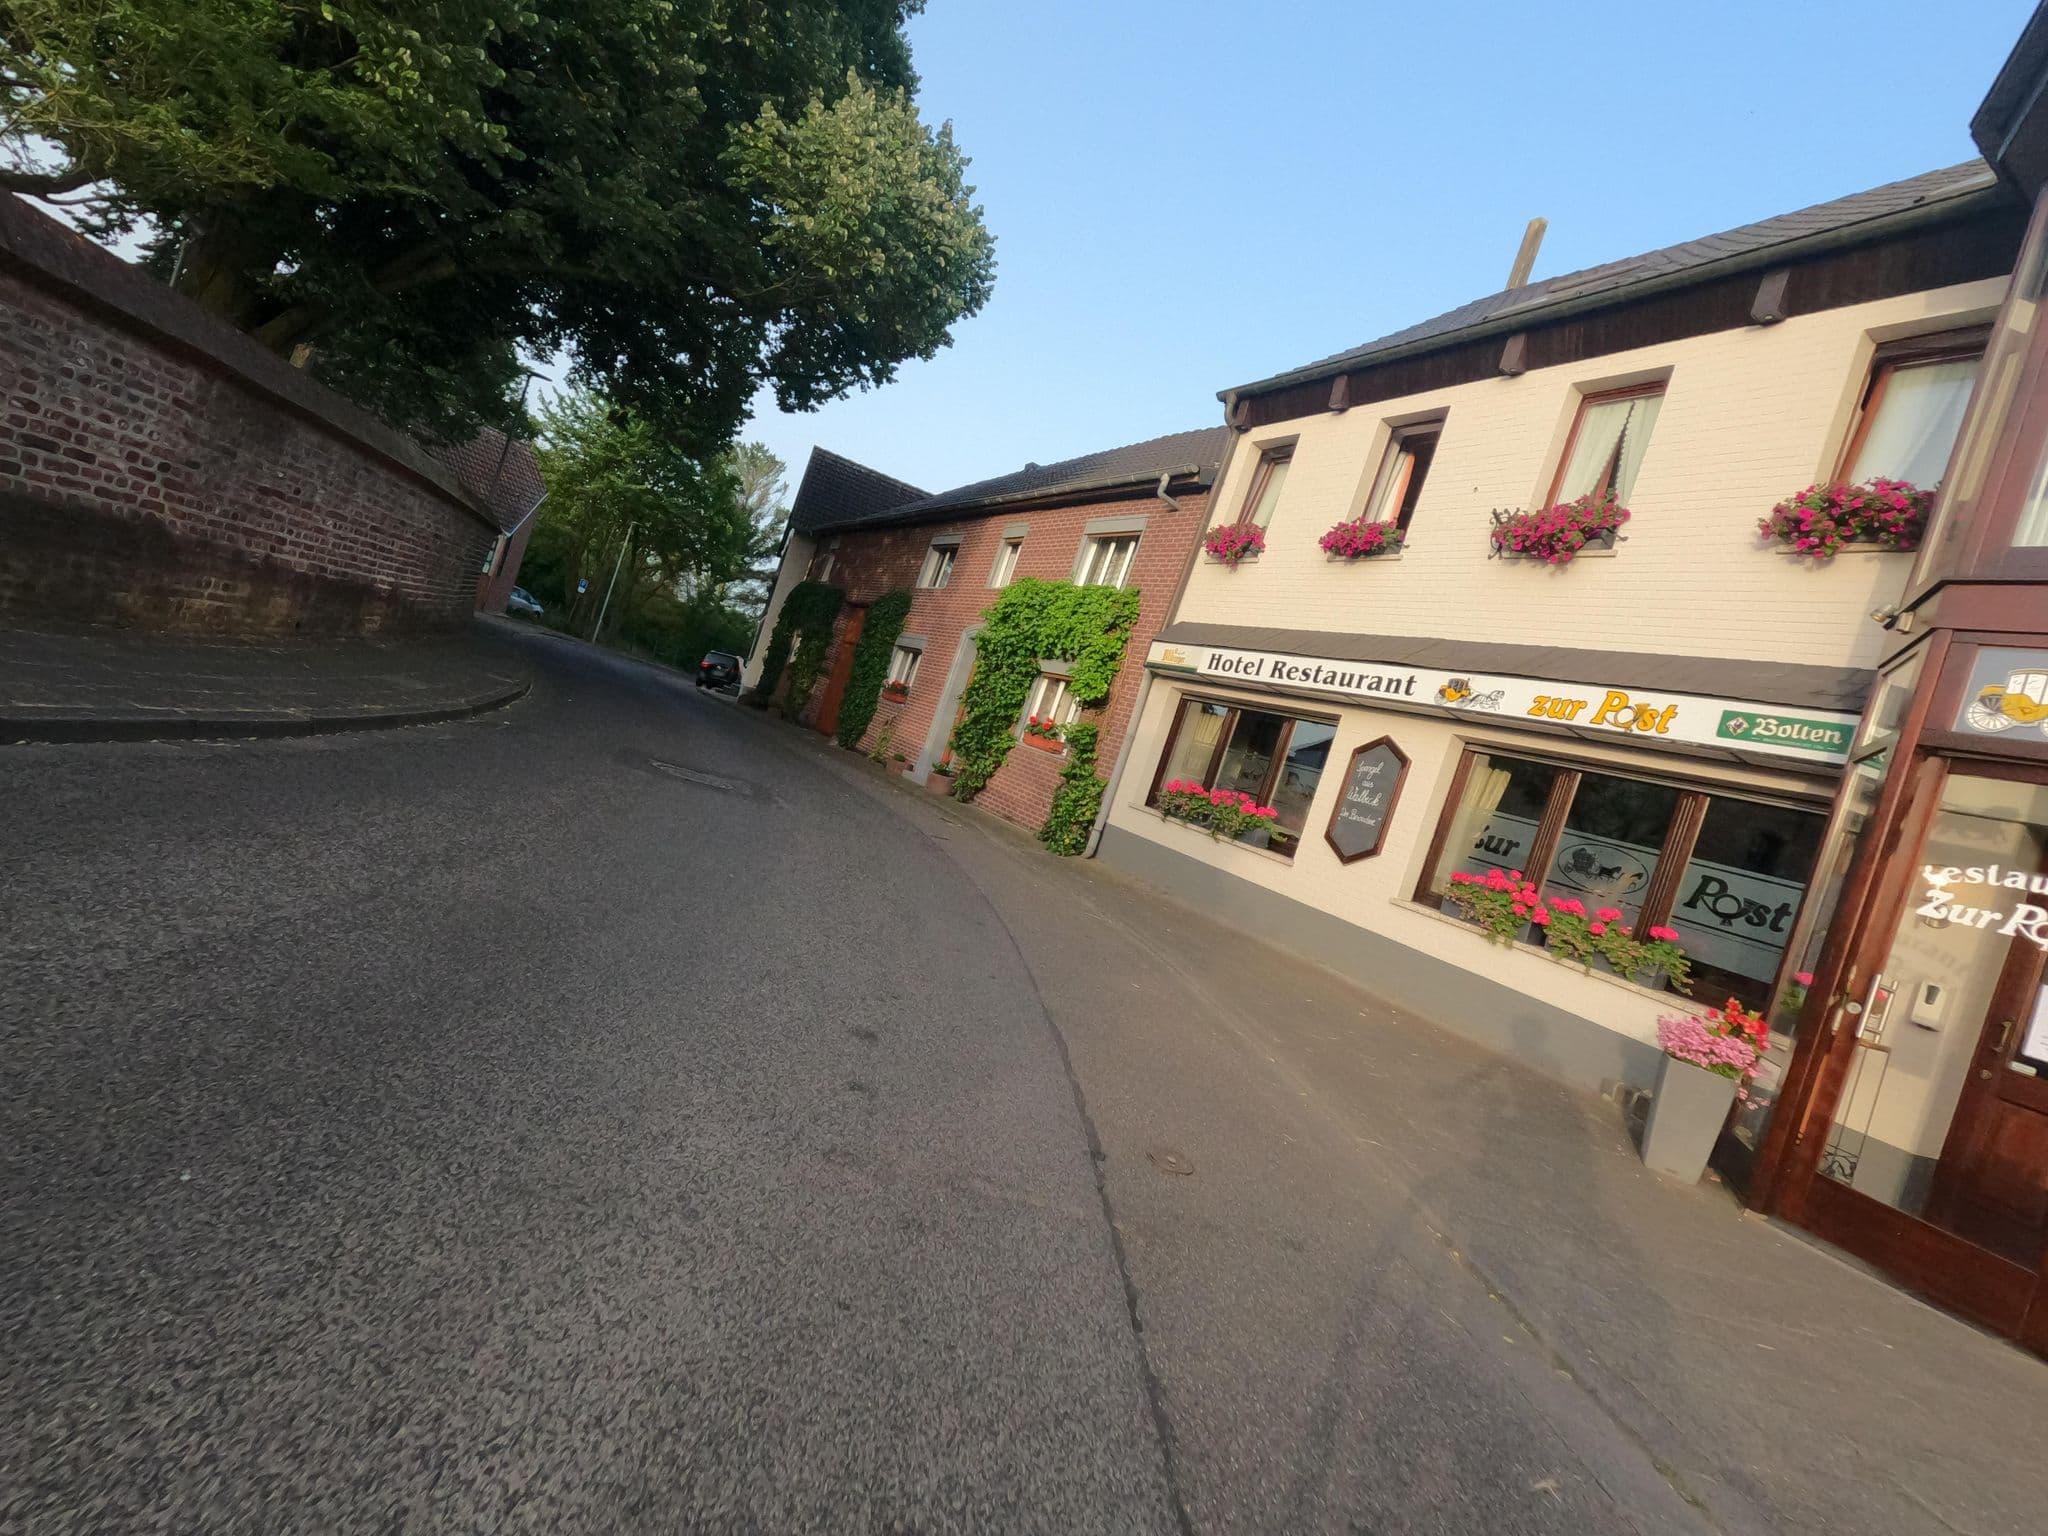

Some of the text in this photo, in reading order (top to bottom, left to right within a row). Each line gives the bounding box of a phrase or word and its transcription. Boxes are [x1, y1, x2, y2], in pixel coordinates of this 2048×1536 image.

[1206, 653, 1264, 677] Hotel
[1269, 660, 1418, 697] Restaurant
[1527, 690, 1680, 734] zur Post
[1752, 717, 1843, 745] Bolten
[1682, 874, 1793, 933] Post
[1915, 888, 2004, 929] Zur
